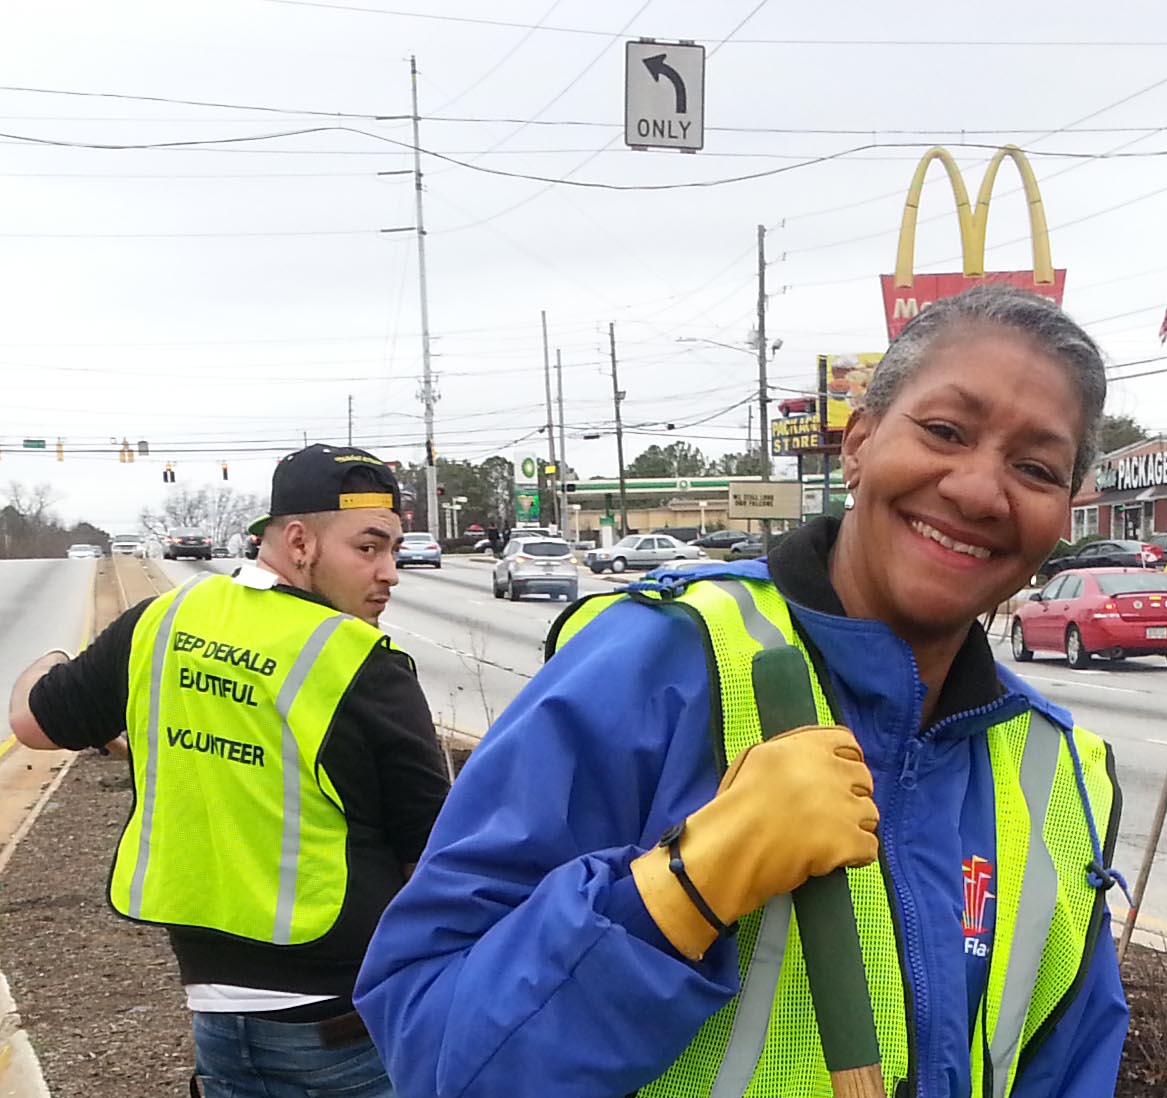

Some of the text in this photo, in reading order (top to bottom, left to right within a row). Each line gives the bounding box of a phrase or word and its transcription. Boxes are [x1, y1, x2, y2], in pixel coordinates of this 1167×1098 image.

[637, 118, 692, 139] ONLY
[773, 434, 819, 453] STORE
[173, 631, 277, 676] EEP DEKALB
[167, 727, 265, 767] VOUNTEER
[964, 937, 990, 957] Fla
